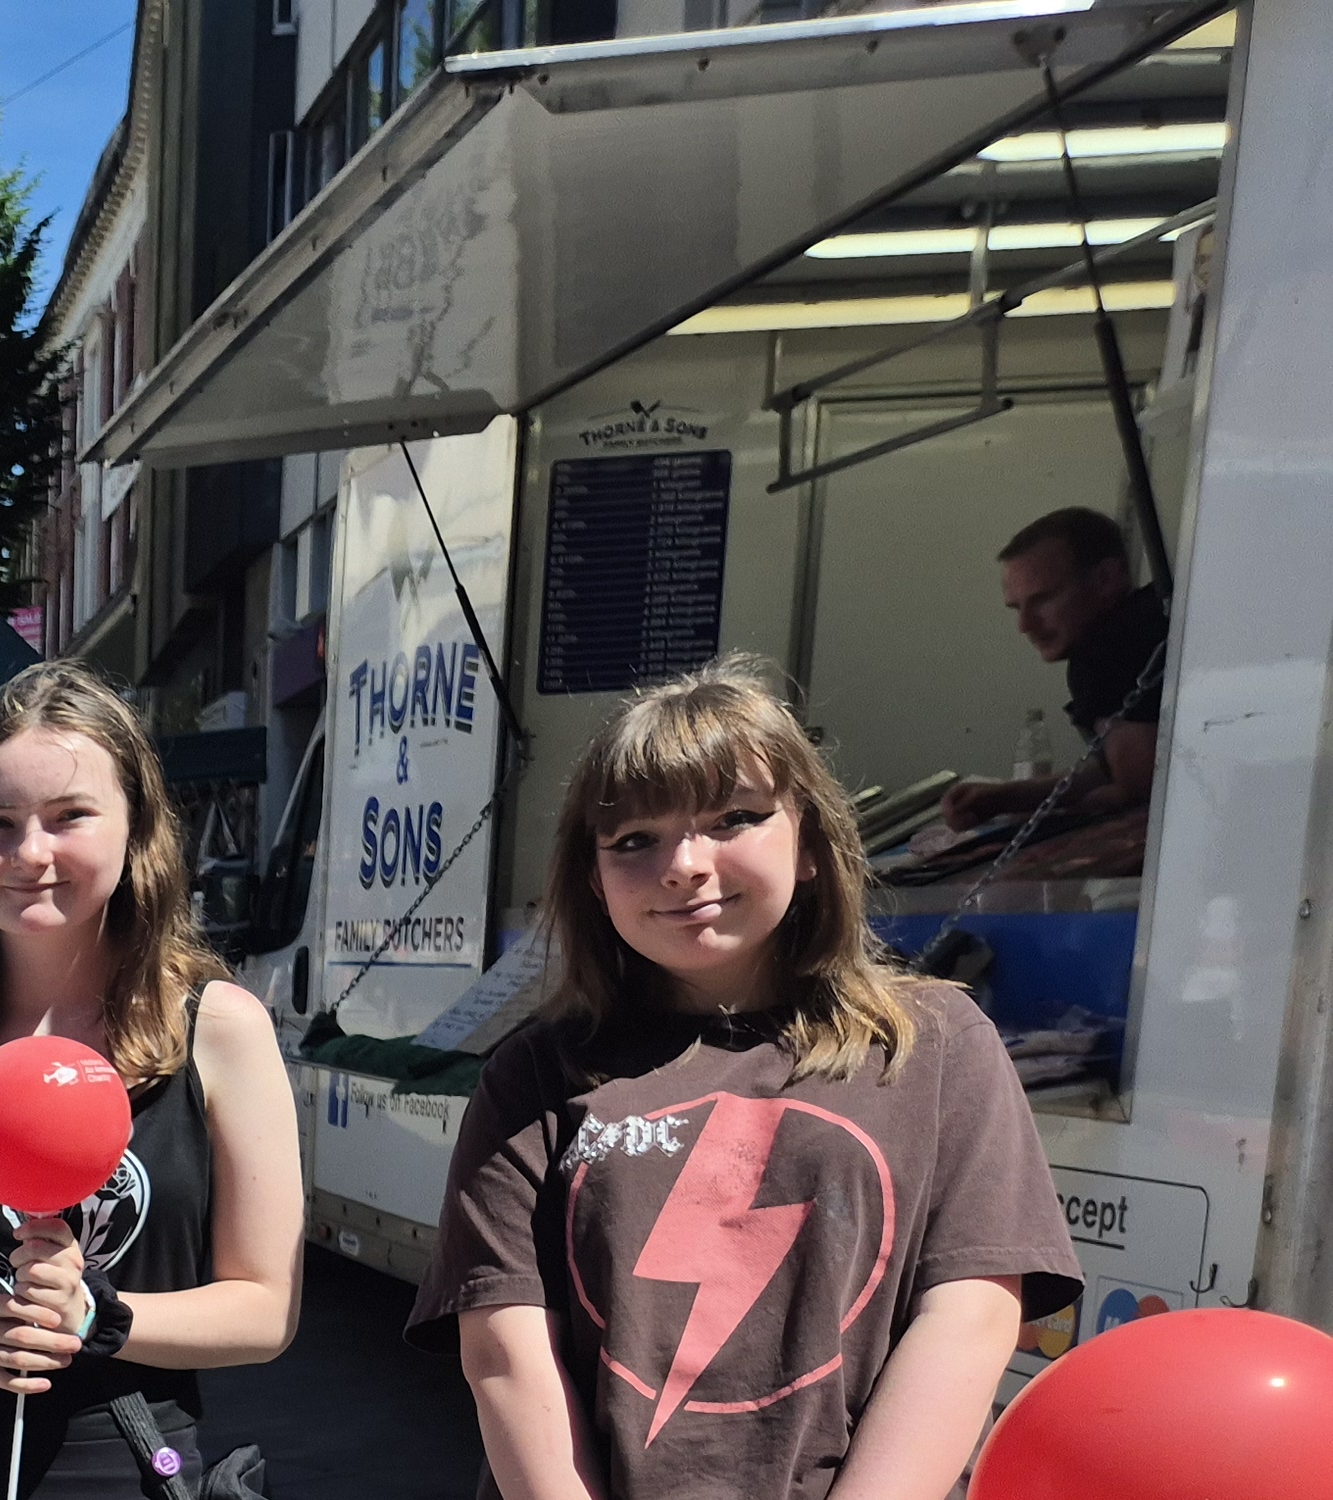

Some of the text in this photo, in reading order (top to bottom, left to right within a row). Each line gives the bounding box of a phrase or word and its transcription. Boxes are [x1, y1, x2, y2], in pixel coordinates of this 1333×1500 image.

[349, 642, 479, 757] THORNE
[396, 736, 409, 785] &
[358, 796, 443, 890] SONS
[335, 916, 465, 953] FAMILY BUTCHERS
[1057, 1193, 1128, 1238] cept
